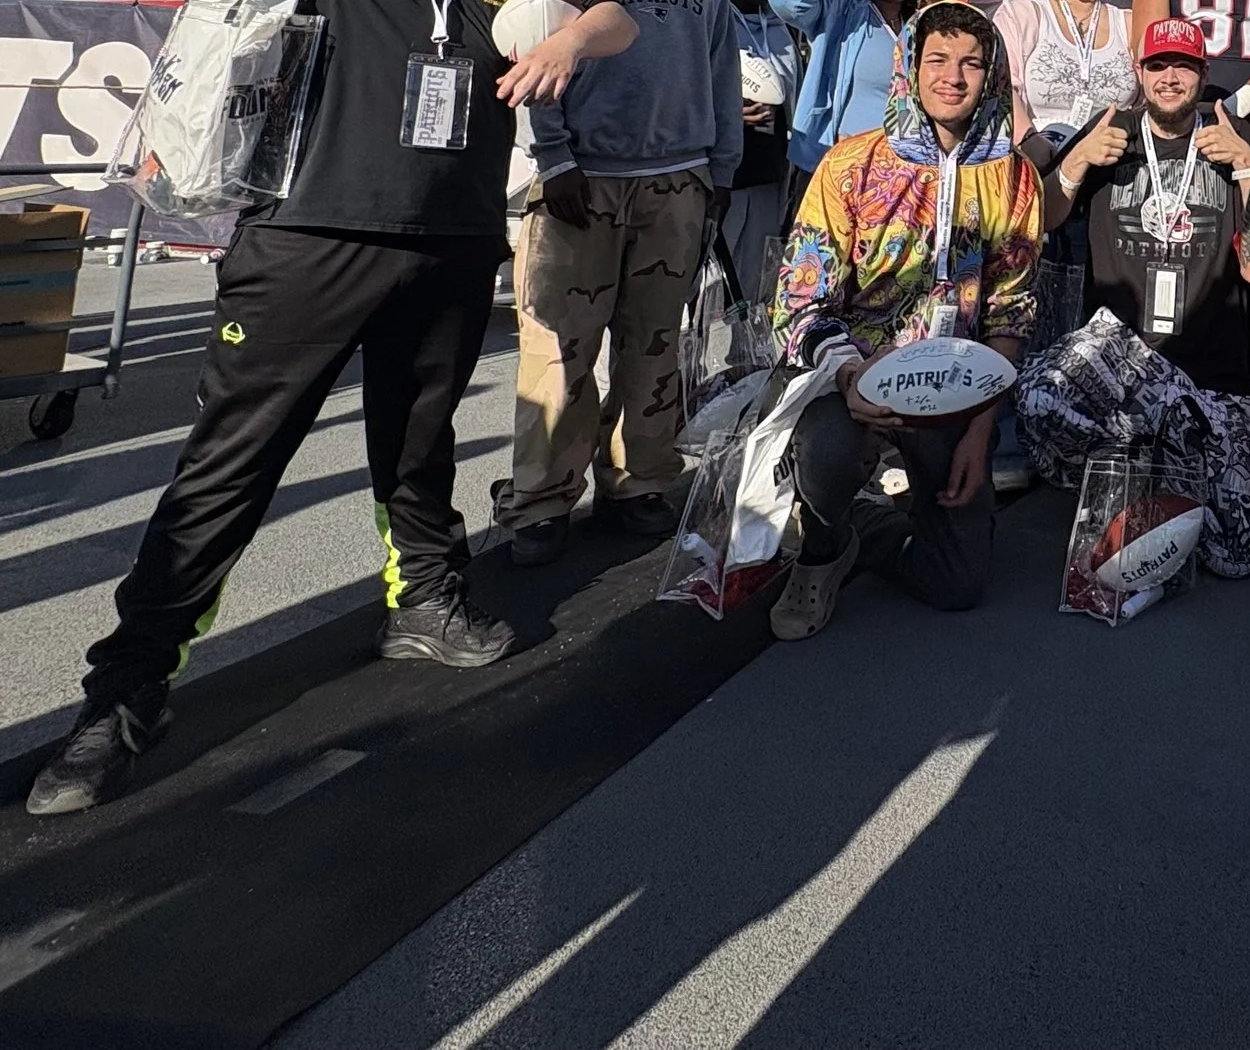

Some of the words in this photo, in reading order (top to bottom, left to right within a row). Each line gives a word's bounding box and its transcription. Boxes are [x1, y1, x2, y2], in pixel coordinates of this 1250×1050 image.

[1153, 20, 1195, 42] PATRIOTS
[896, 368, 973, 392] PATRIS
[1122, 540, 1179, 584] PATRIOTS
